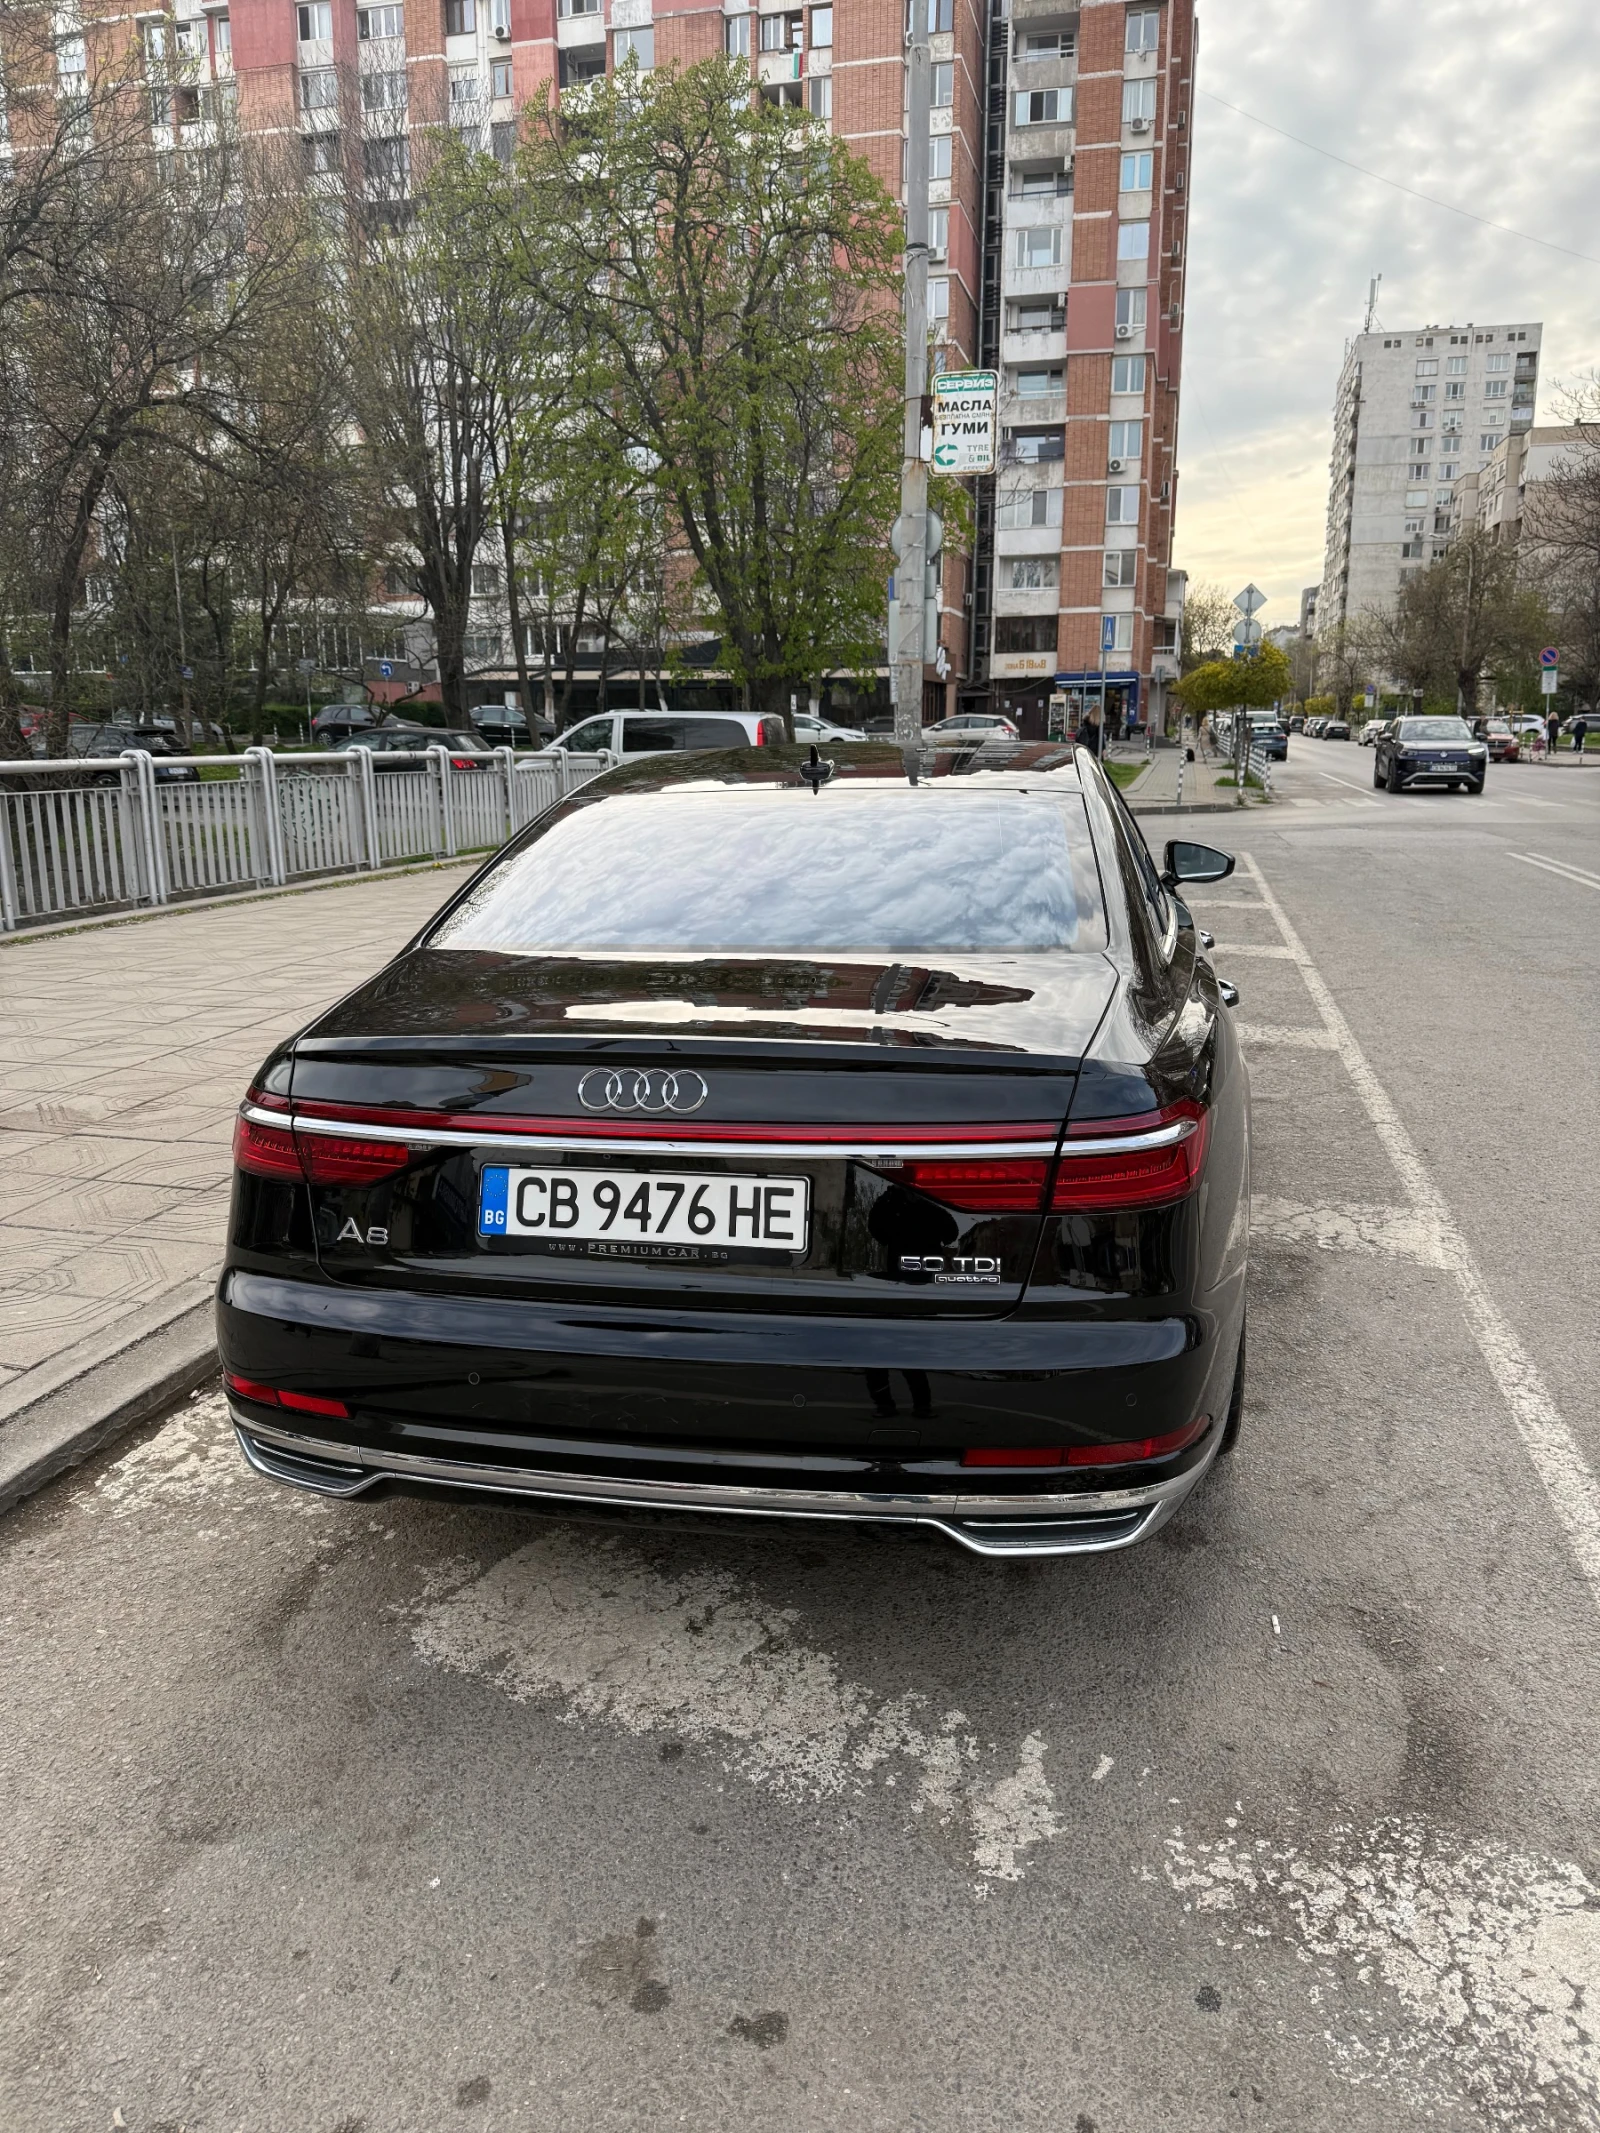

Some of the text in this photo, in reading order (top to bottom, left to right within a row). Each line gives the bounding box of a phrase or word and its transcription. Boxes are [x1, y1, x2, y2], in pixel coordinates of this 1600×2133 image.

[937, 378, 993, 391] СЕРВИЗ
[938, 400, 992, 412] МАСЛА
[941, 421, 988, 436] ГУМИ
[967, 444, 989, 452] TYRE
[968, 454, 991, 463] & OIL
[516, 1177, 795, 1240] CB 9476 HE
[484, 1209, 505, 1226] BG
[336, 1217, 388, 1245] A8
[900, 1256, 1001, 1272] 50 TDI
[936, 1275, 999, 1283] quattro
